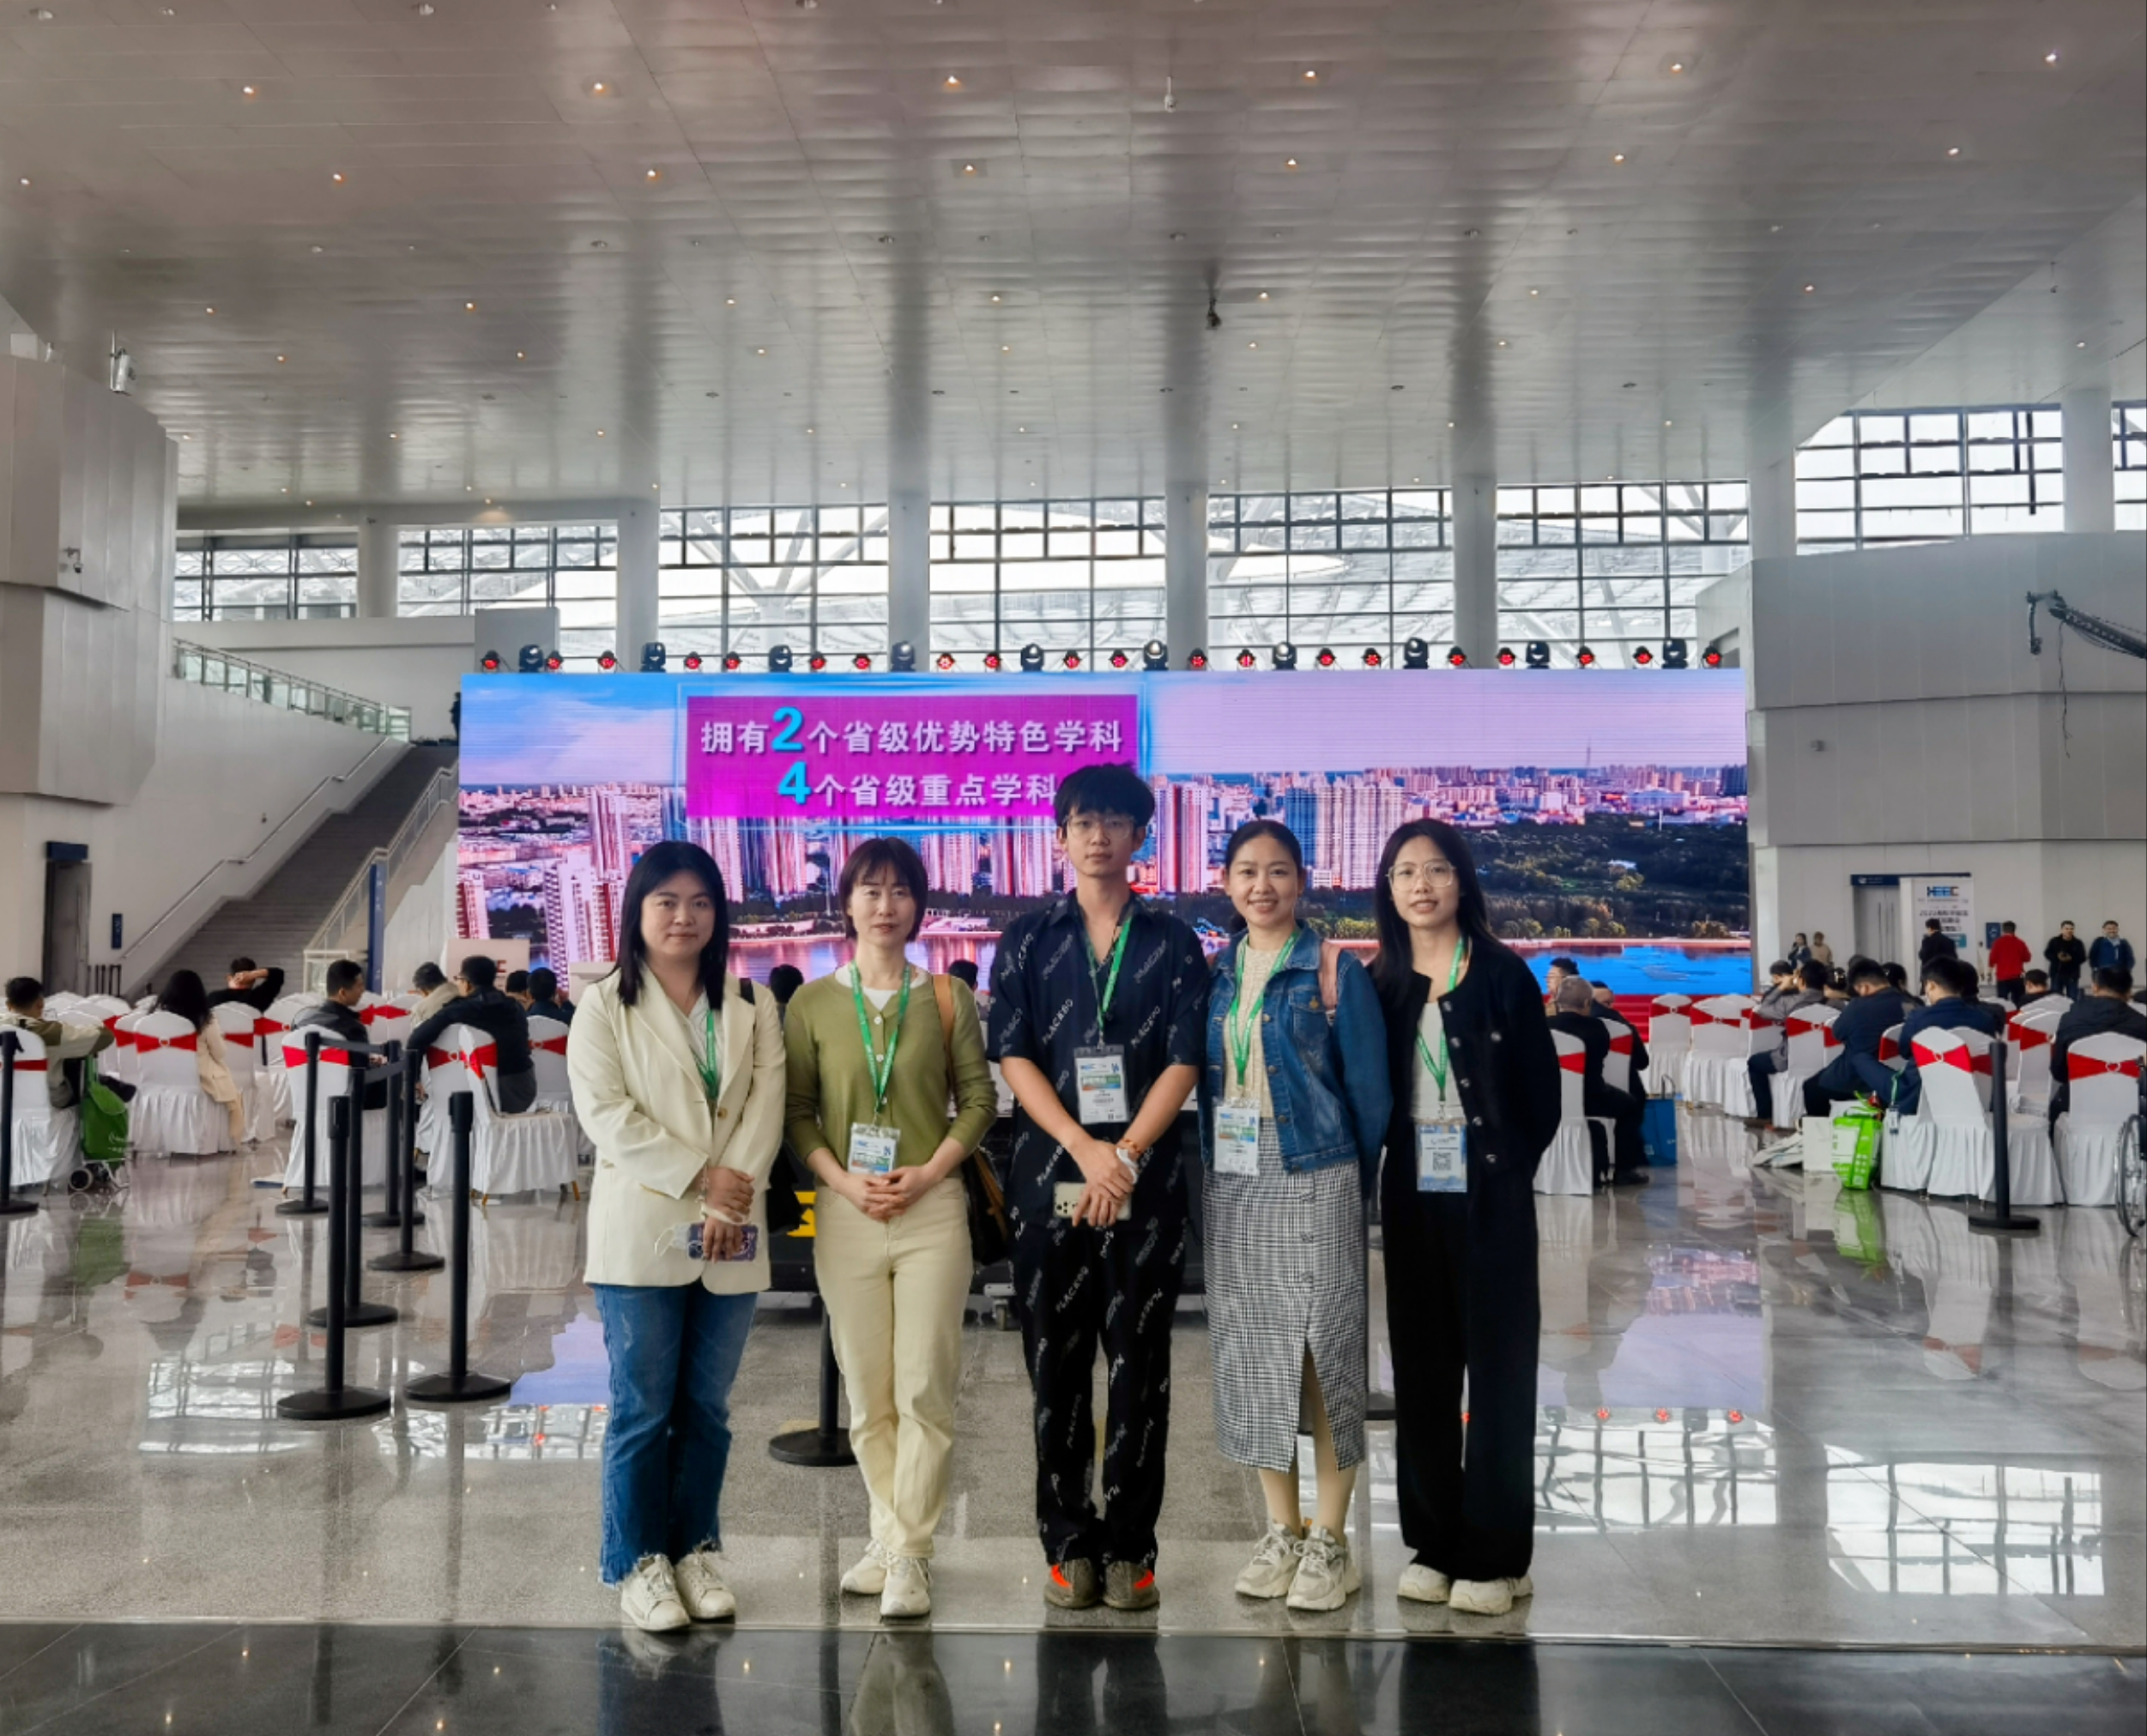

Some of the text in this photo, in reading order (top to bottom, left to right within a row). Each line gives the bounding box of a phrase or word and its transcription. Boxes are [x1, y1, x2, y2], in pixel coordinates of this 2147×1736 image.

[700, 707, 1123, 754] 拥有2个省级优势特色学科
[777, 761, 1058, 806] 4个省级重点学科
